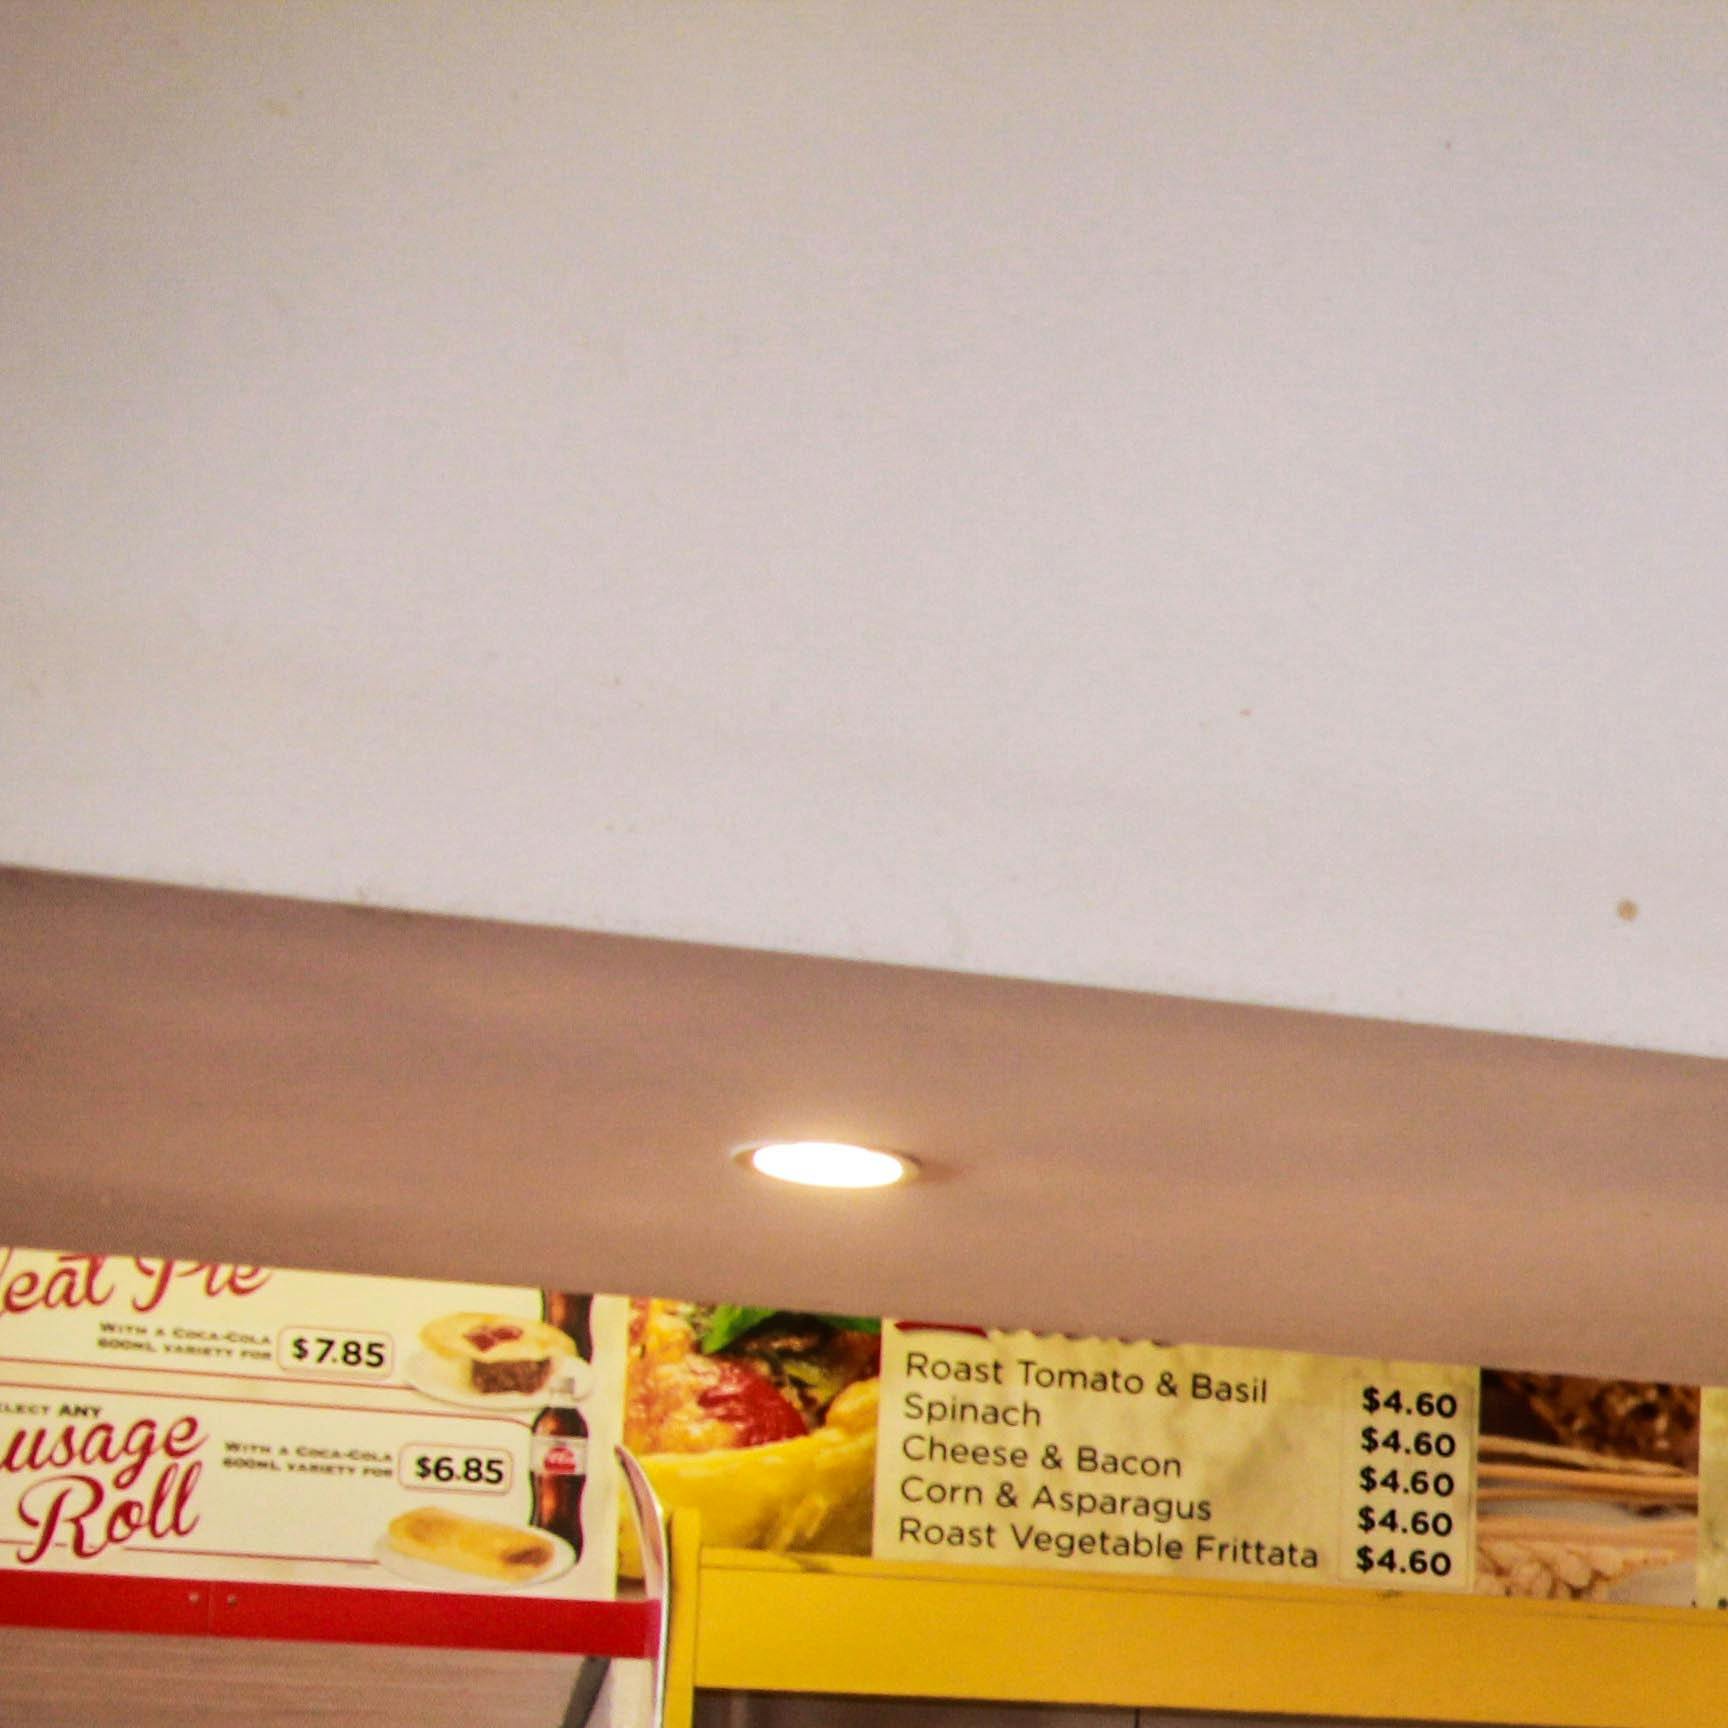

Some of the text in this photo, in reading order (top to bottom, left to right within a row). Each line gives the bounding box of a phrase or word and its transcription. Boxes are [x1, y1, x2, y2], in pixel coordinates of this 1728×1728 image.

[0, 1247, 116, 1316] eat
[291, 1336, 387, 1369] $7.85
[906, 1352, 1268, 1404] Roast Tomato & Basil
[58, 1405, 103, 1419] ANY
[904, 1395, 1041, 1428] Spinach
[1362, 1385, 1458, 1419] $4.60
[0, 1414, 209, 1491] usage
[903, 1435, 1183, 1479] Cheese & Bacon
[1361, 1426, 1457, 1459] $4.60
[415, 1455, 505, 1486] $6.85
[1359, 1466, 1455, 1498] $4.60
[16, 1460, 204, 1565] Roll
[901, 1477, 1212, 1524] Corn & Asparagus
[1358, 1506, 1454, 1538] $4.60
[900, 1518, 1318, 1570] Roast Vegetable Frittata
[1356, 1546, 1452, 1578] $4.60
